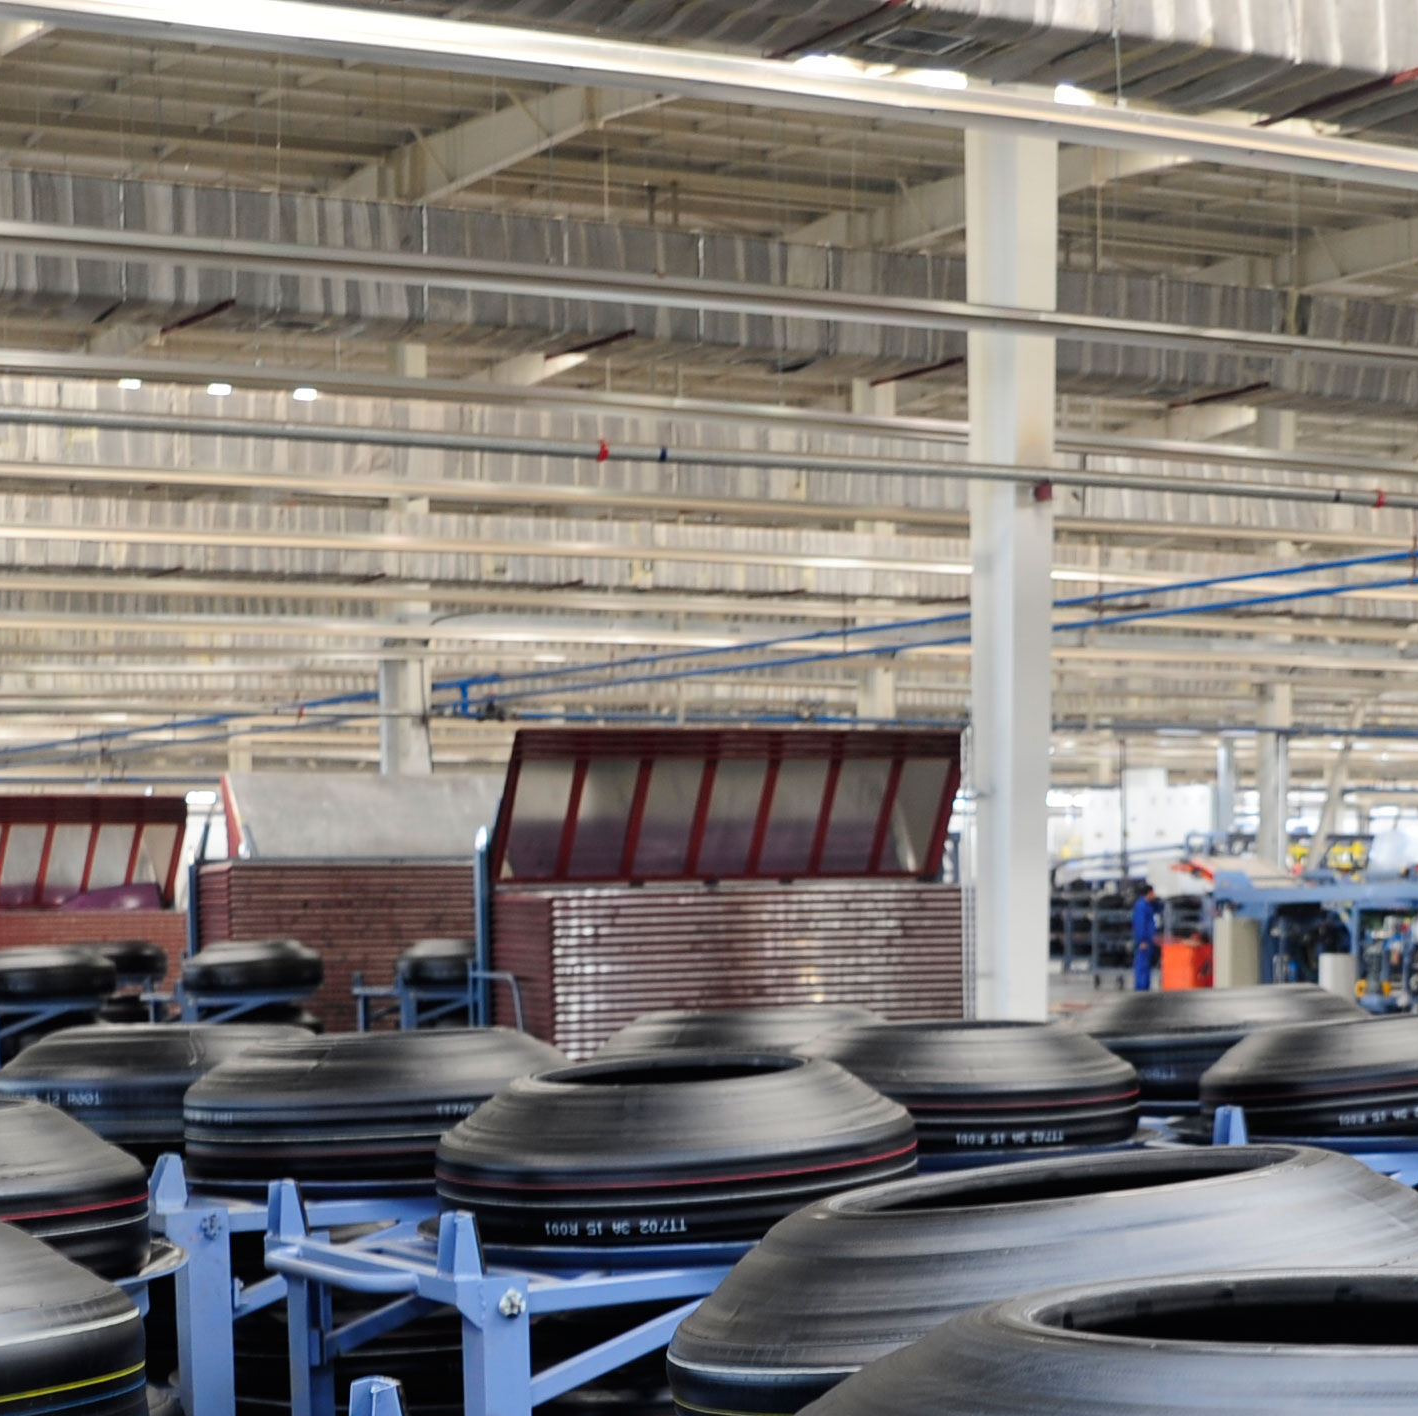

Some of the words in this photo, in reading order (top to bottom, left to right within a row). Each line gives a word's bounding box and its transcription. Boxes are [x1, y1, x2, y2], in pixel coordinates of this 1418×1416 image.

[545, 1221, 579, 1237] R001
[586, 1220, 602, 1237] 15
[612, 1219, 630, 1235] 3A
[640, 1217, 687, 1234] TT702
